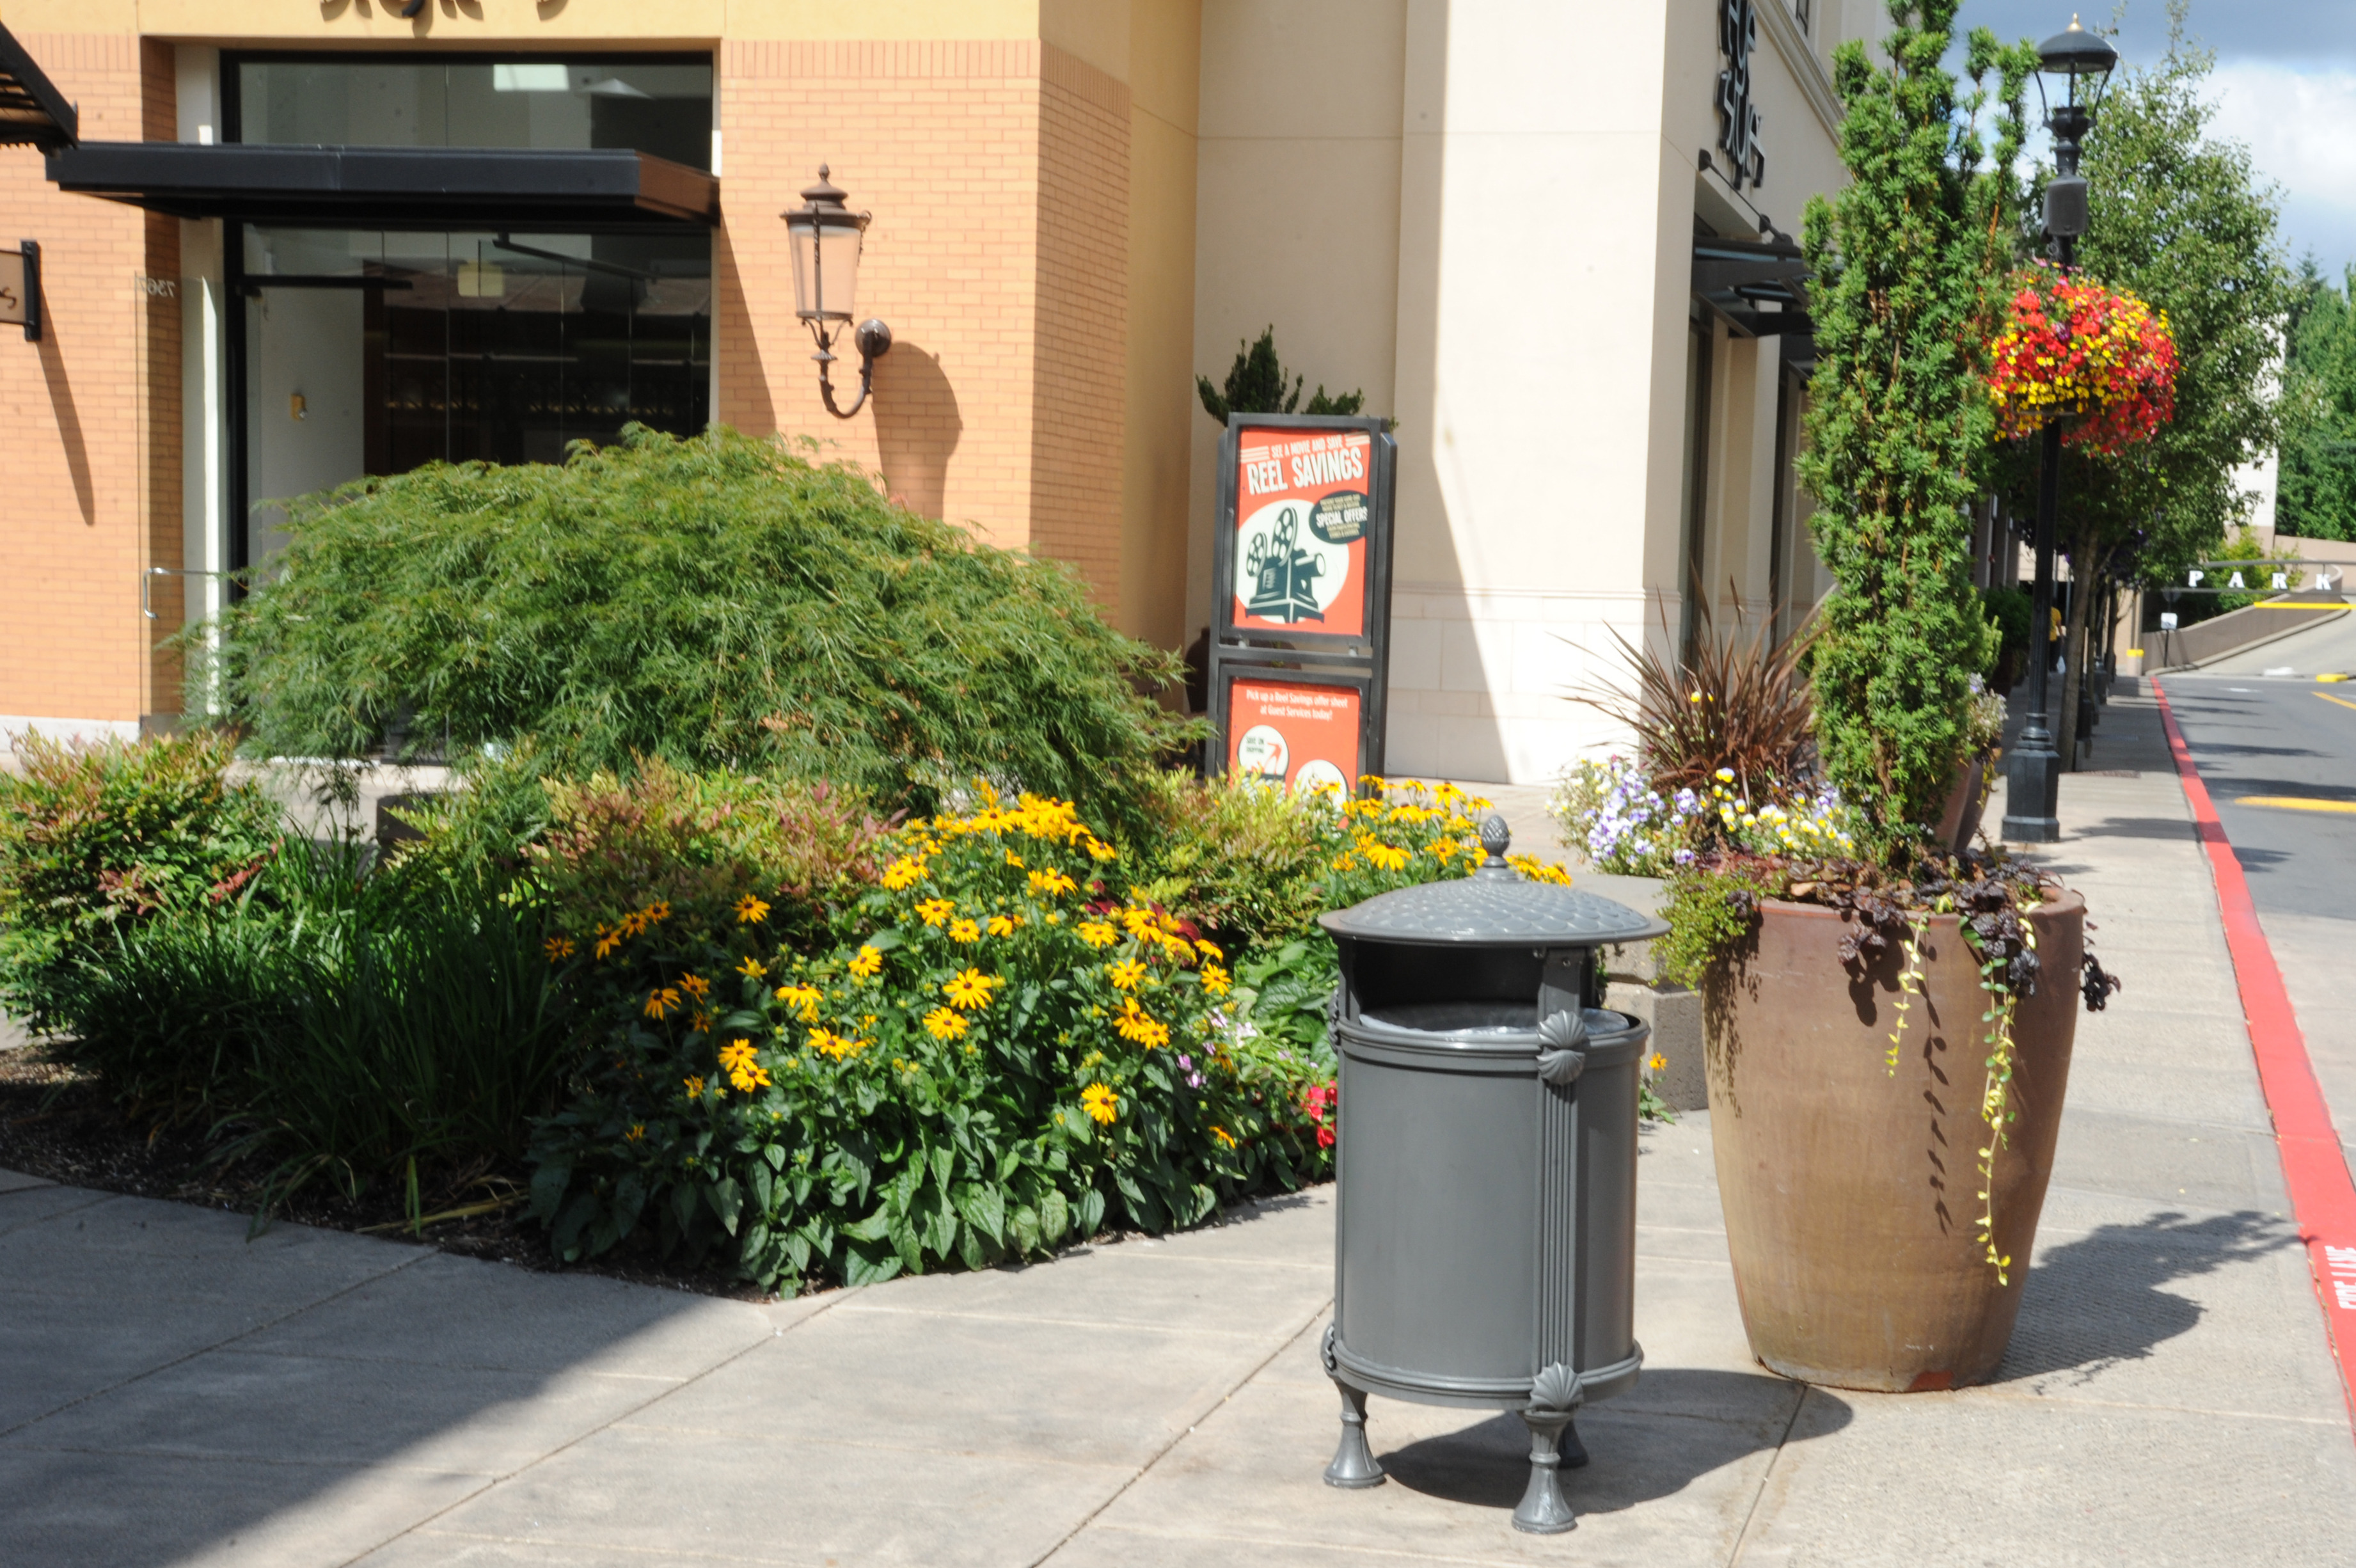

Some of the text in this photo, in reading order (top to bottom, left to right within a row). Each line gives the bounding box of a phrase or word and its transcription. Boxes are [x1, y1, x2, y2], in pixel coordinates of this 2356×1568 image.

[1271, 434, 1343, 459] SEE A MOVIE AND SAVE
[1247, 447, 1364, 495] REEL SAVINGS
[1316, 511, 1343, 528] SPECIAL
[1343, 506, 1368, 523] OFFERS
[2188, 570, 2332, 590] PARK
[1246, 689, 1259, 701] Pick
[1260, 692, 1268, 702] up
[1275, 691, 1288, 704] Reel
[1290, 693, 1313, 706] Savings
[1314, 695, 1330, 707] offer
[1331, 697, 1348, 708] sheet
[1260, 705, 1267, 715] at
[1268, 705, 1285, 717] Guest
[1286, 706, 1311, 718] Services
